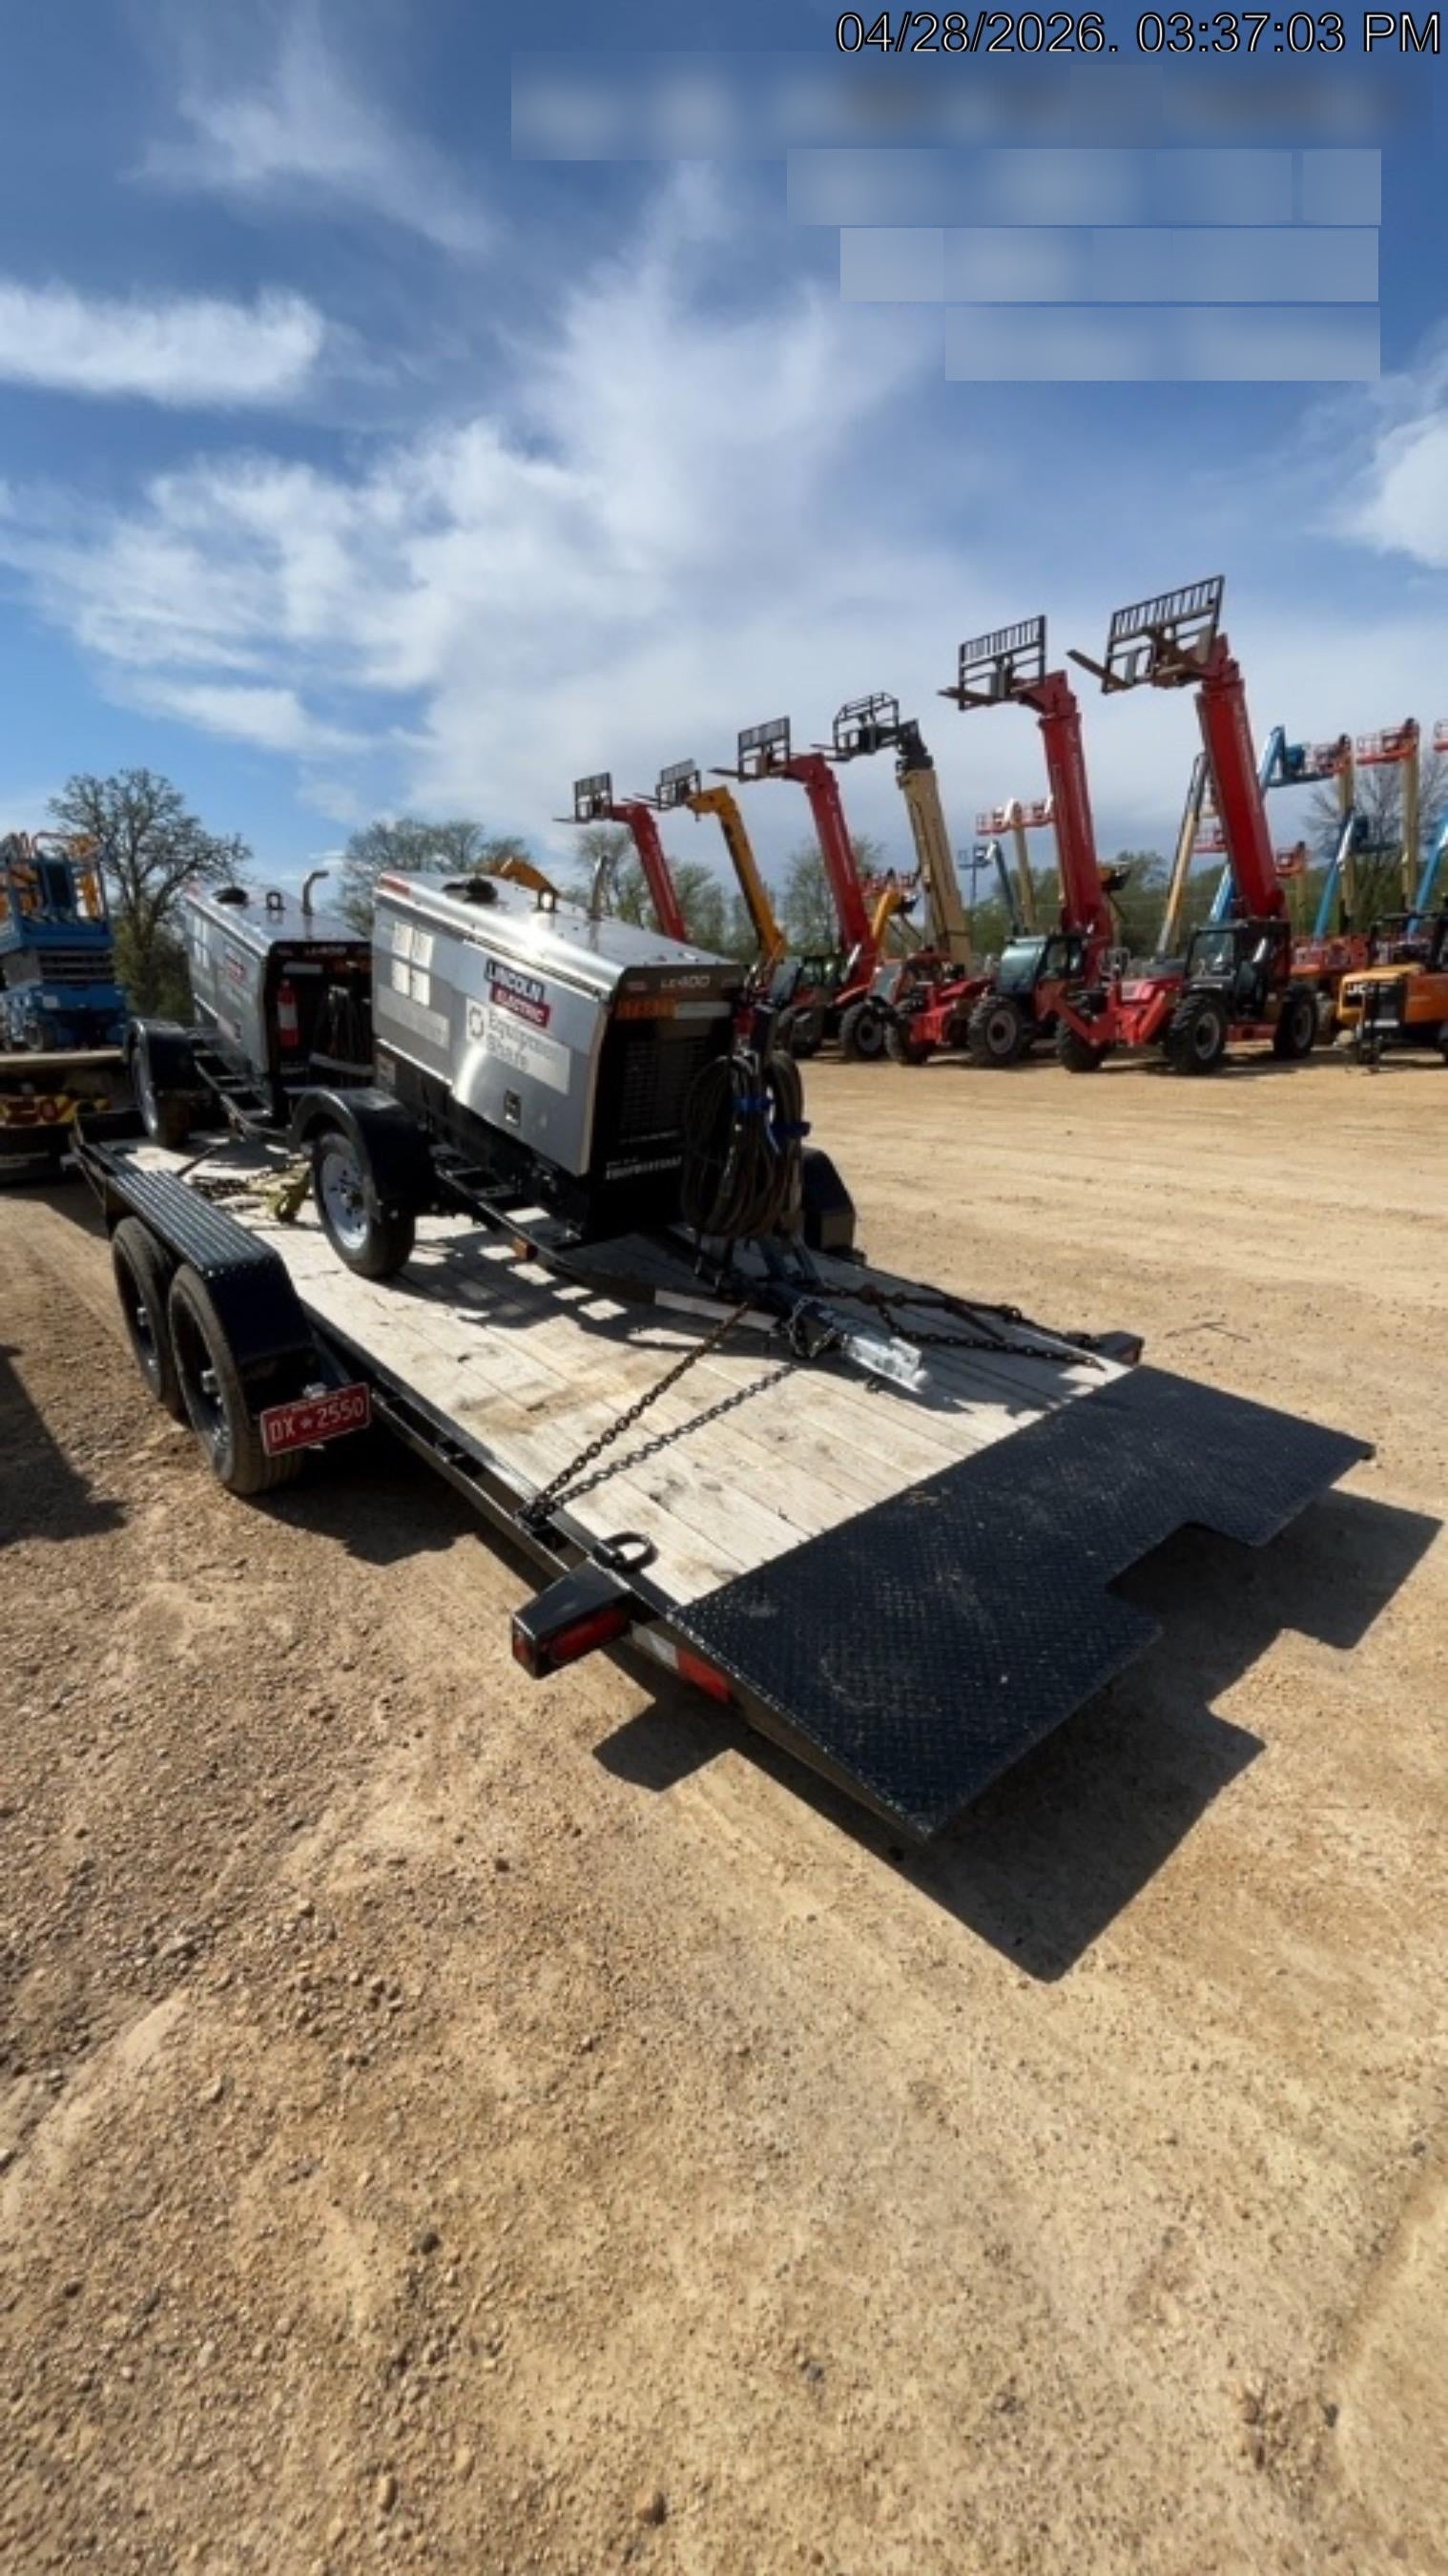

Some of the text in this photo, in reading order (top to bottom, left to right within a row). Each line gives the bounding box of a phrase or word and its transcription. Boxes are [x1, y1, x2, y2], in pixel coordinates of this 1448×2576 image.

[485, 959, 545, 1005] LINCOLN
[495, 987, 546, 1024] ELECTRIC
[486, 1032, 528, 1069] Share
[269, 1417, 296, 1444] DX
[317, 1396, 364, 1429] 2550
